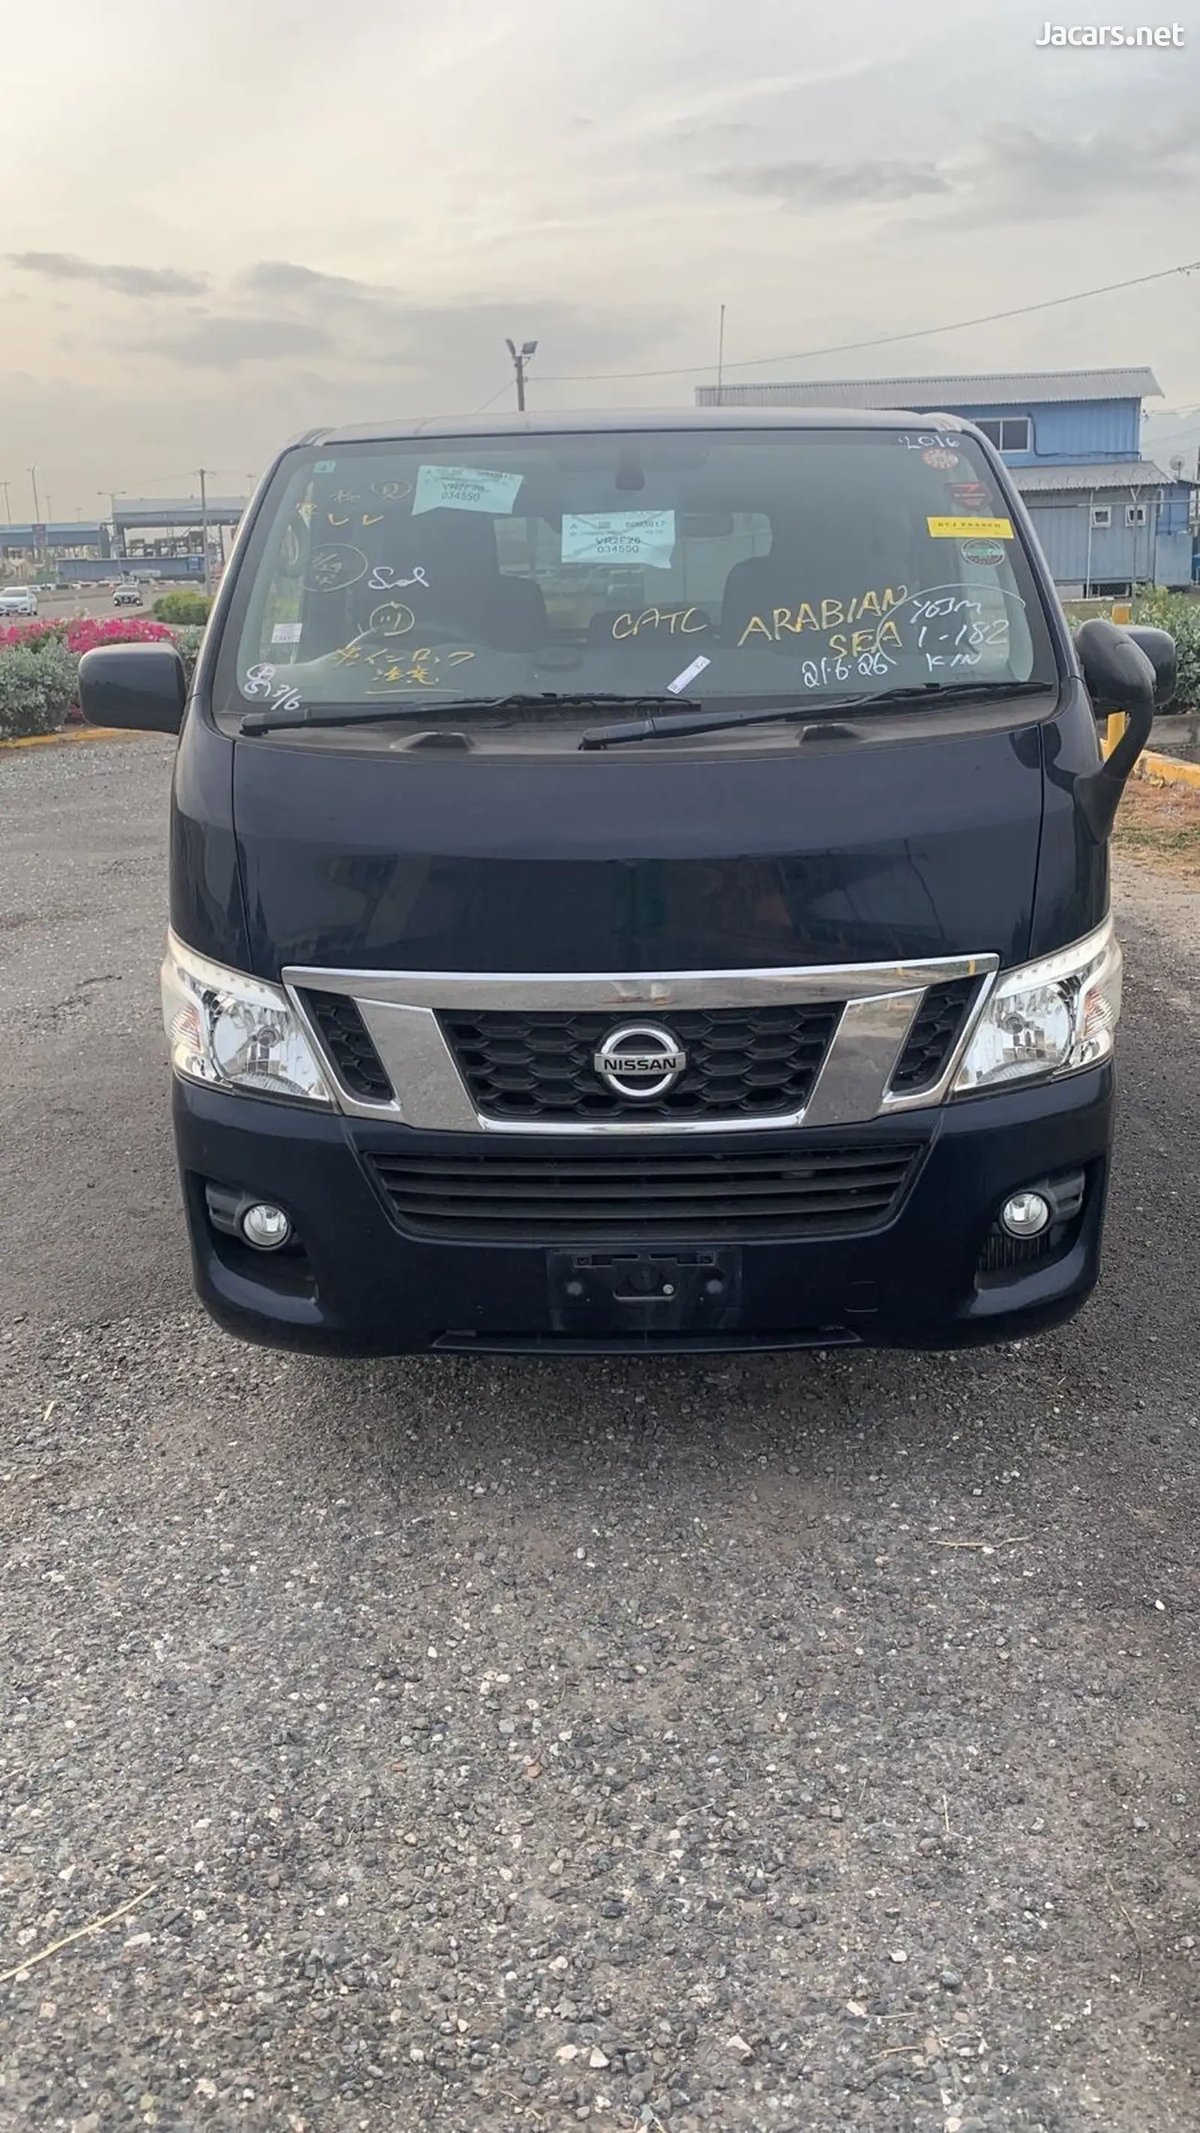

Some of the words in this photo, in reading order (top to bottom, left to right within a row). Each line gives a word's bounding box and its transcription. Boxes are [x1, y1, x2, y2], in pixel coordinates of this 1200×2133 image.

[738, 585, 907, 648] ARABIAN
[829, 620, 903, 661] SEA
[604, 1057, 677, 1071] NISSAN
